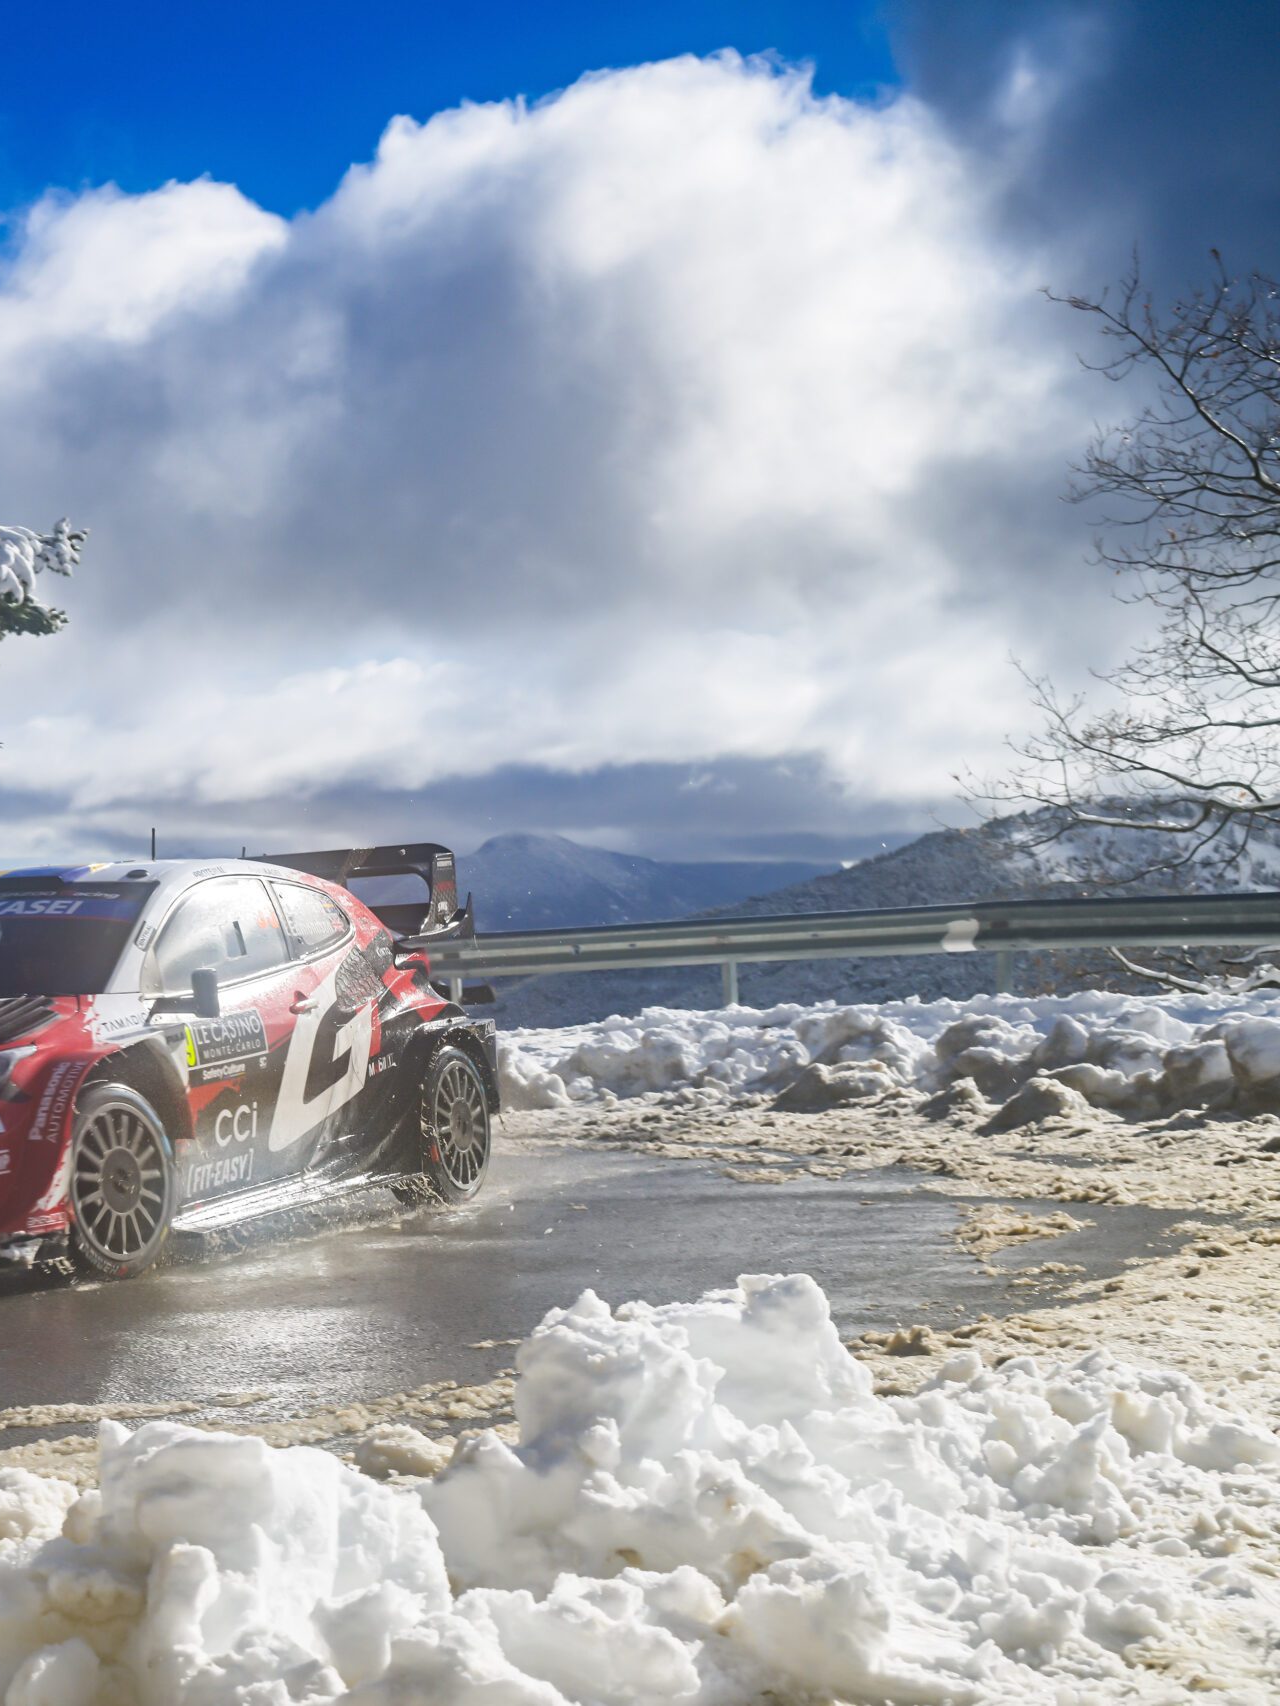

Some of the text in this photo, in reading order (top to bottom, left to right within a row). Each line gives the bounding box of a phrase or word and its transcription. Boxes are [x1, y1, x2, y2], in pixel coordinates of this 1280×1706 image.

[194, 1025, 210, 1046] LE
[210, 1015, 262, 1044] CASINO
[203, 1038, 262, 1059] MONTE-CARLO
[28, 1061, 71, 1141] Panasonic
